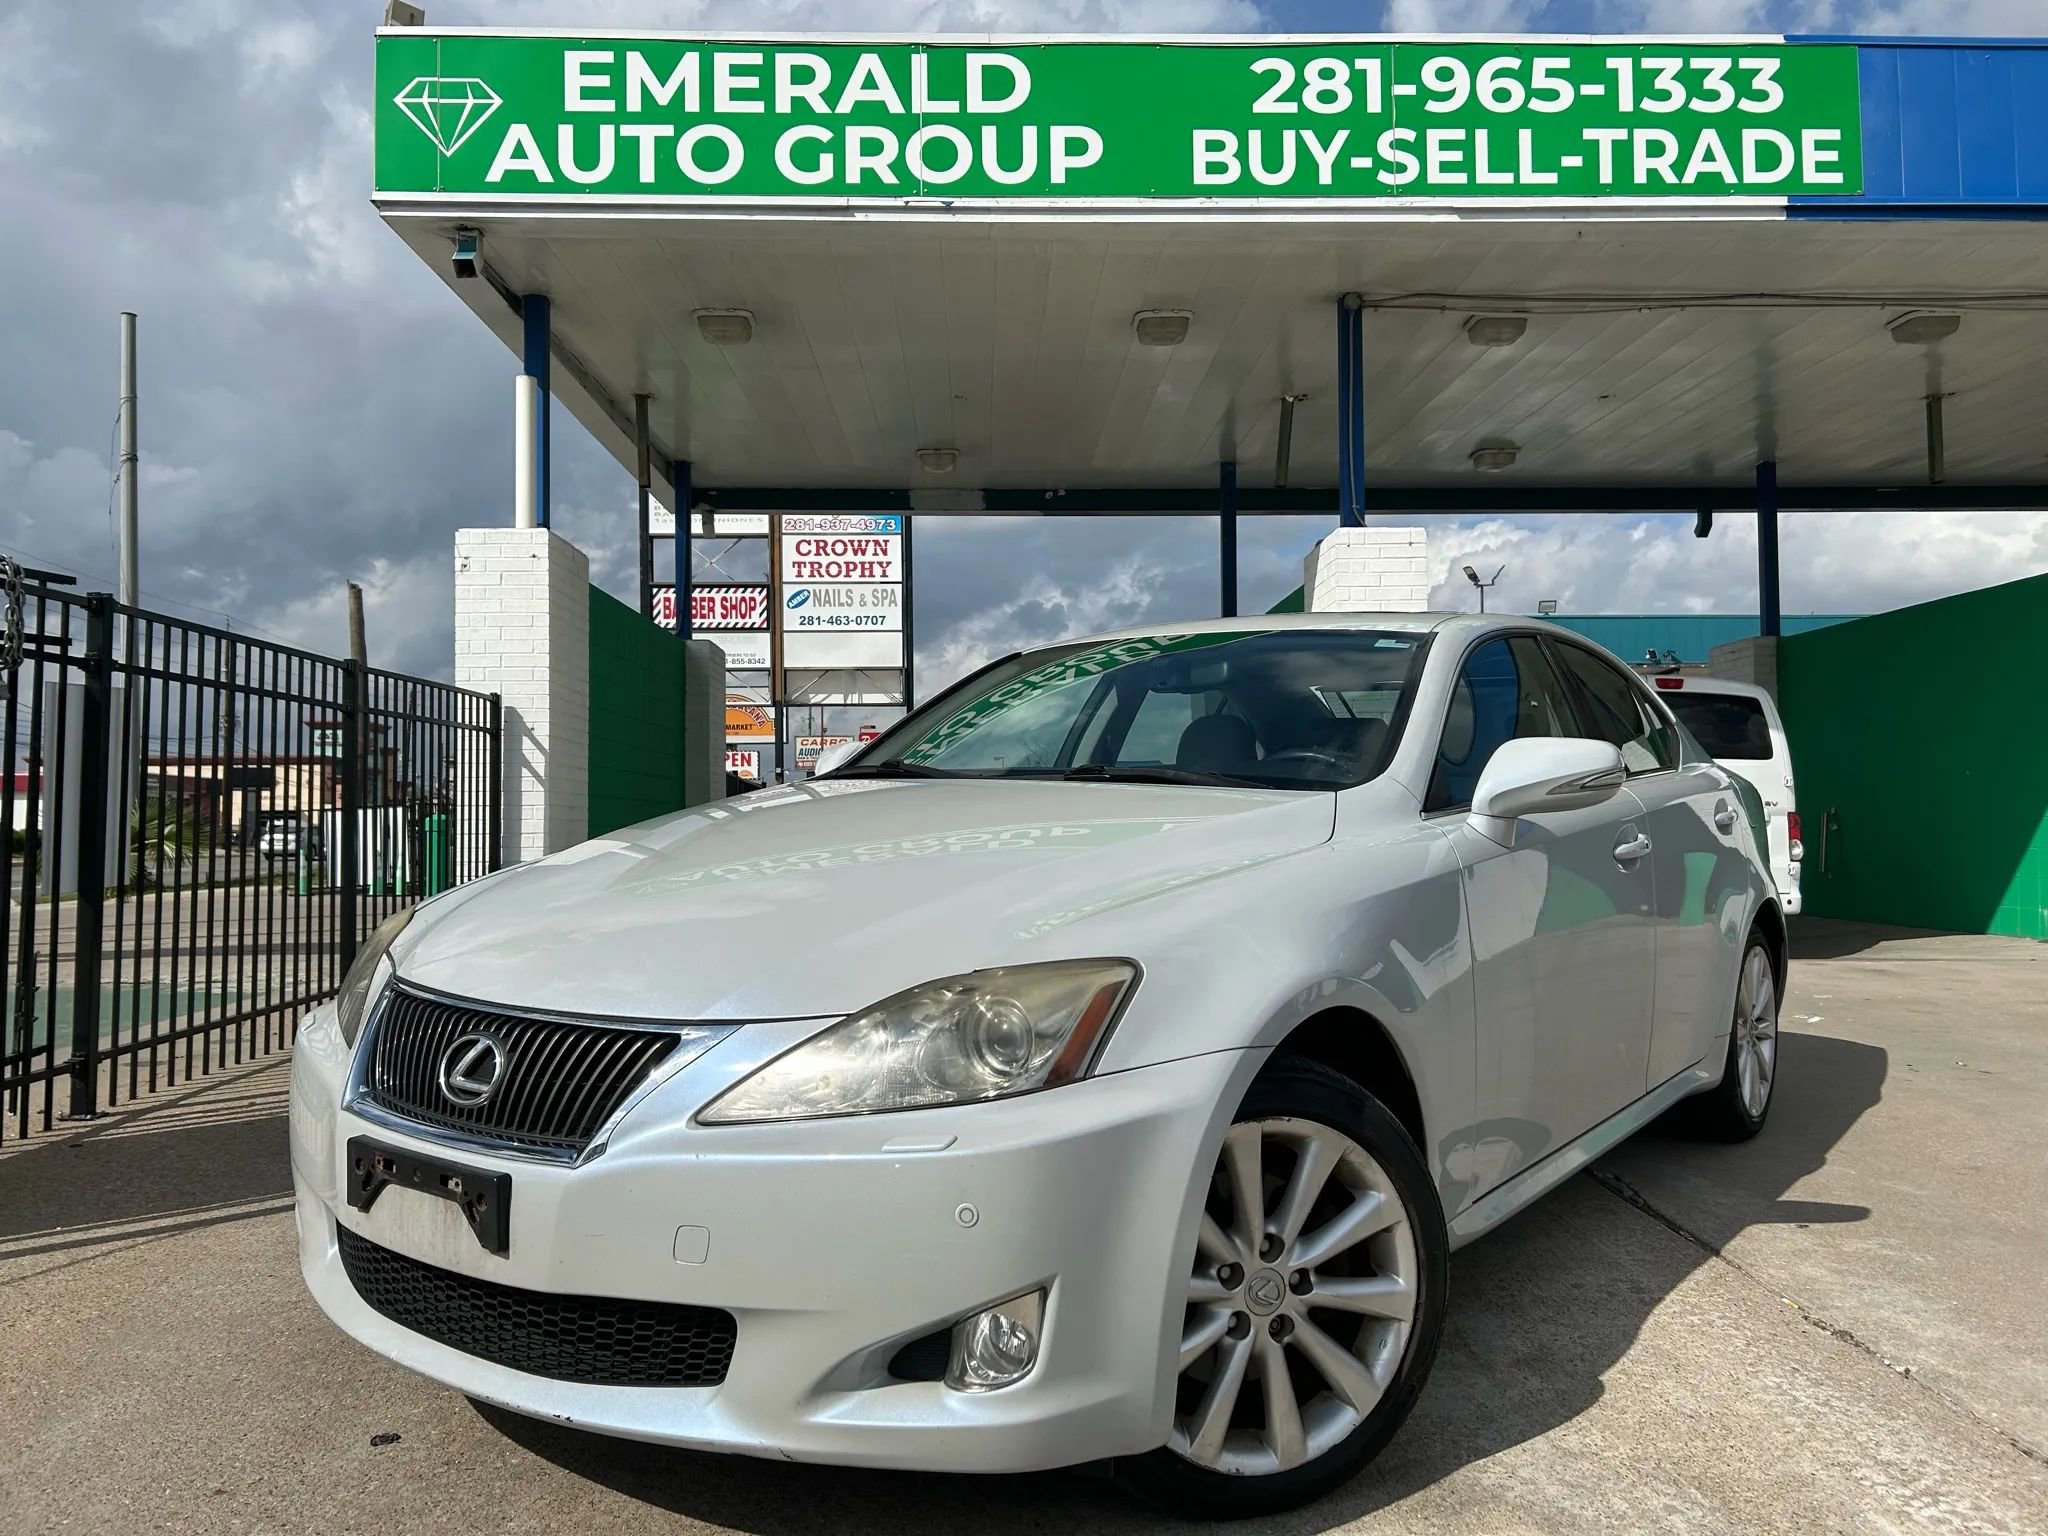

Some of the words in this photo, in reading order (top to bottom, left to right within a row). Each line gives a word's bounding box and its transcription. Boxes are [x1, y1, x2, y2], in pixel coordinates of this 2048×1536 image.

[563, 50, 1033, 115] EMERALD
[1249, 56, 1785, 115] 281-965-1333
[484, 123, 746, 185] AUTO
[773, 124, 1105, 186] GROUP
[1191, 127, 1844, 186] BUY-SELL-TRADE
[784, 518, 897, 531] 281-937-4973
[795, 539, 890, 556] CROWN
[792, 561, 892, 578] TROPHY
[663, 596, 716, 619] BABER
[720, 596, 757, 619] SHOP
[787, 590, 810, 608] AMBER
[812, 588, 854, 607] NAILS
[858, 593, 867, 608] &
[871, 588, 898, 607] SPA
[799, 615, 887, 626] 281-463-0707
[725, 723, 753, 731] MARKET
